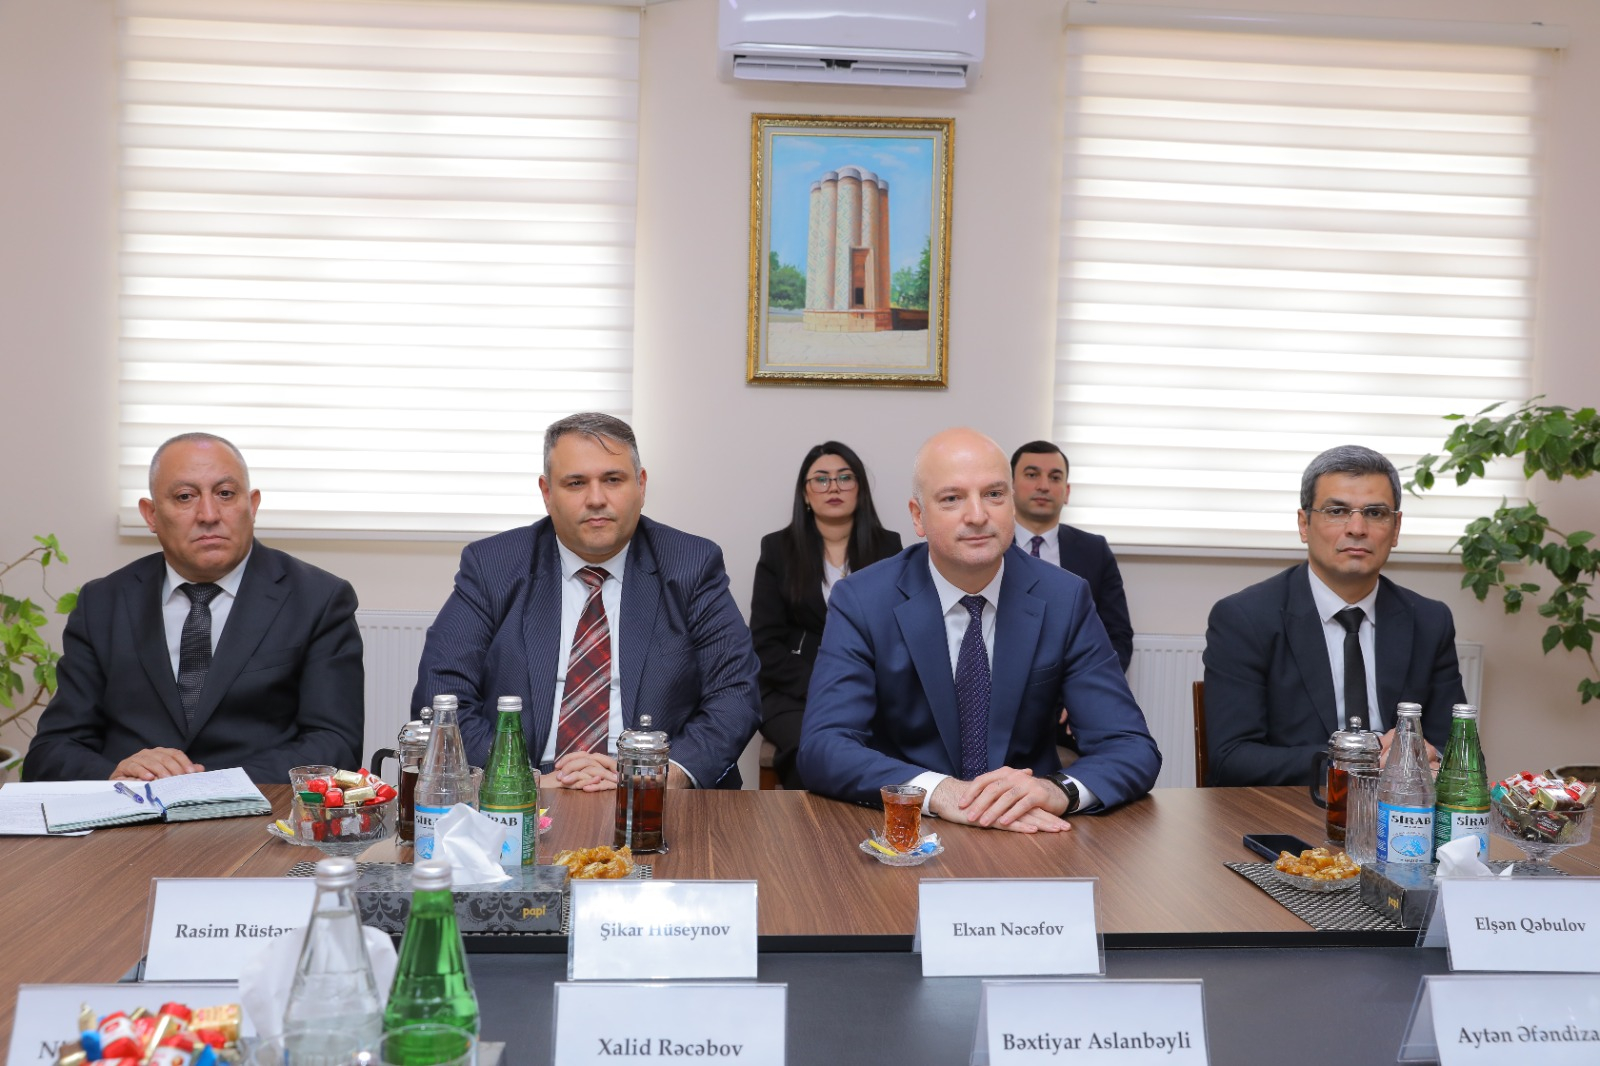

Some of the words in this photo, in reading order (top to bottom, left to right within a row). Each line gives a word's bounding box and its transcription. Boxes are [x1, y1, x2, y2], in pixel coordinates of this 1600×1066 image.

[1390, 815, 1432, 825] SİRAB
[522, 904, 547, 919] papi
[175, 923, 230, 938] Rasim
[600, 922, 644, 941] Şikar
[648, 922, 731, 941] Hüseynov
[952, 922, 997, 937] Elxan
[1000, 921, 1064, 936] Nəcəfov
[1475, 917, 1517, 934] Elşən
[1520, 917, 1586, 934] Qəbulov
[1002, 1032, 1082, 1055] Bəxtiyar
[1088, 1031, 1192, 1054] Aslanbəyli
[1458, 1026, 1514, 1049] Aytən
[1517, 1025, 1600, 1043] Əfəndiza
[597, 1038, 652, 1056] Xalid
[658, 1038, 744, 1057] Rəcəbov
